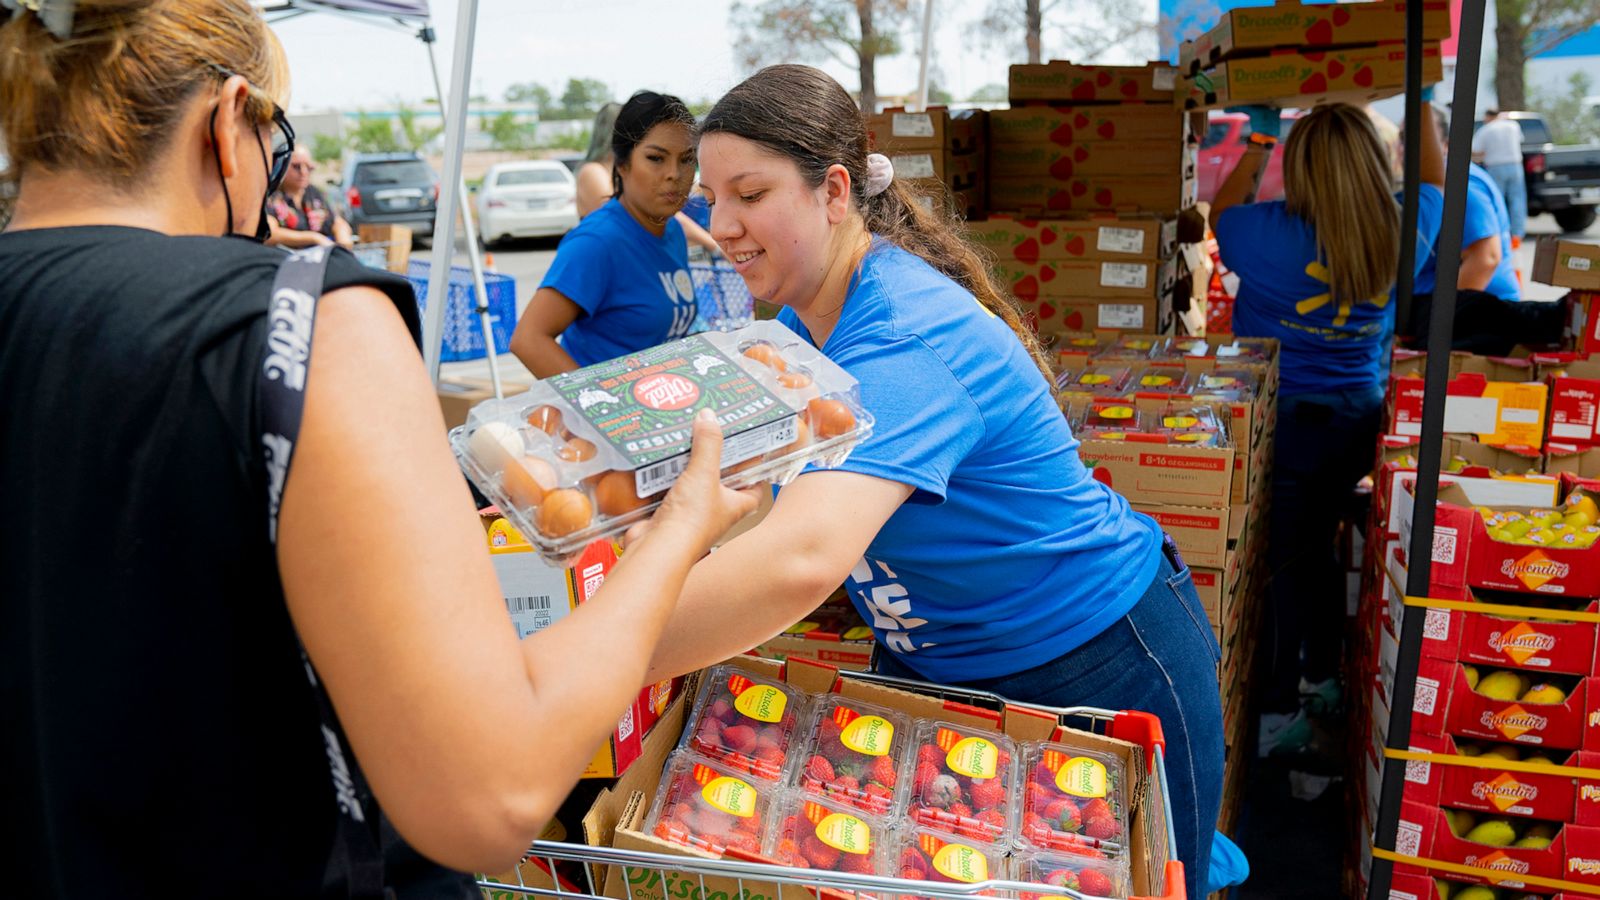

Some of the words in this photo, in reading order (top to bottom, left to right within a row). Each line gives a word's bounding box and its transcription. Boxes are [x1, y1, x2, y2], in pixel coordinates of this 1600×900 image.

[263, 287, 316, 392] 2022
[644, 378, 694, 408] Vital
[1145, 456, 1167, 465] 8-16
